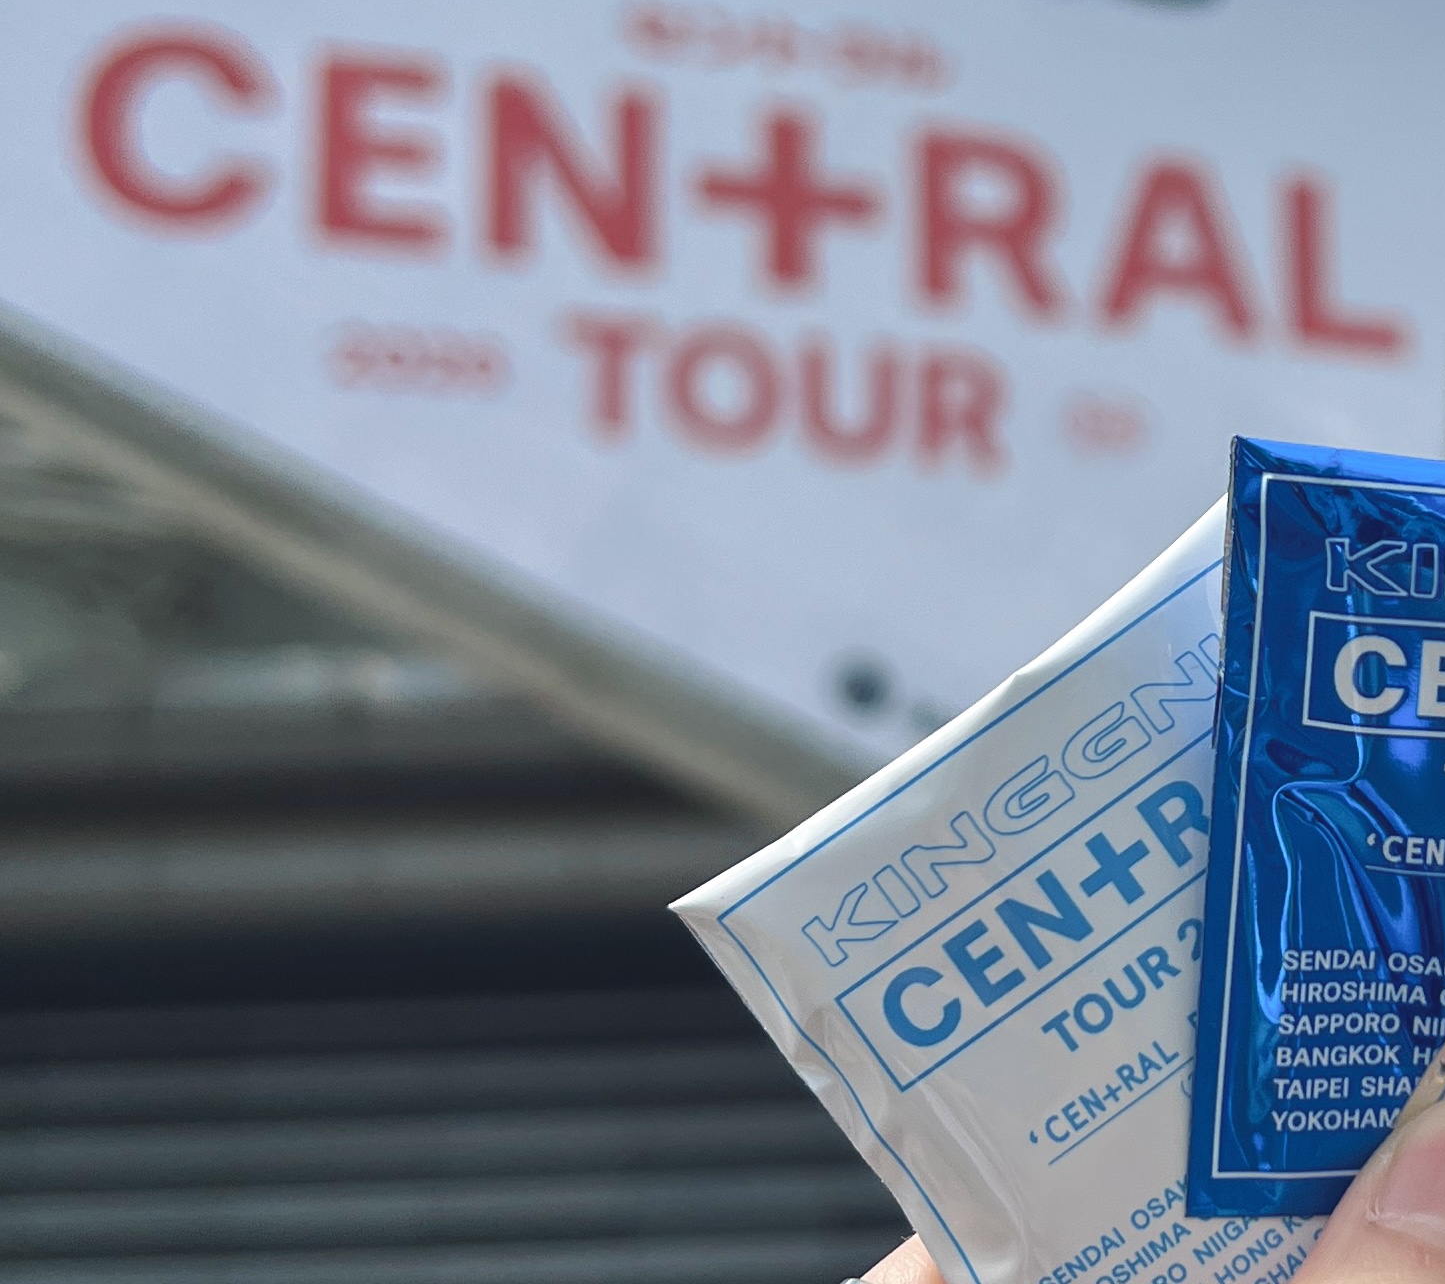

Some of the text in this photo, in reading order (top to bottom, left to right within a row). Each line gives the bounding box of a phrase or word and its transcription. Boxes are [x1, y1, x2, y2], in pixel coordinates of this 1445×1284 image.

[77, 22, 1411, 359] CEN+RAL
[569, 318, 1006, 473] TOUR
[801, 633, 1222, 968] KINGGN
[882, 780, 1209, 1047] CEN+R
[1282, 949, 1376, 971] SENDAI
[1041, 946, 1182, 1052] TOUR
[1280, 981, 1427, 1005] HIROSHIMA
[1278, 1013, 1400, 1035] SAPPORO
[1276, 1044, 1402, 1067] BANGKOK
[1273, 1077, 1349, 1100] TAIPEI
[1271, 1107, 1400, 1132] YOKOHAM
